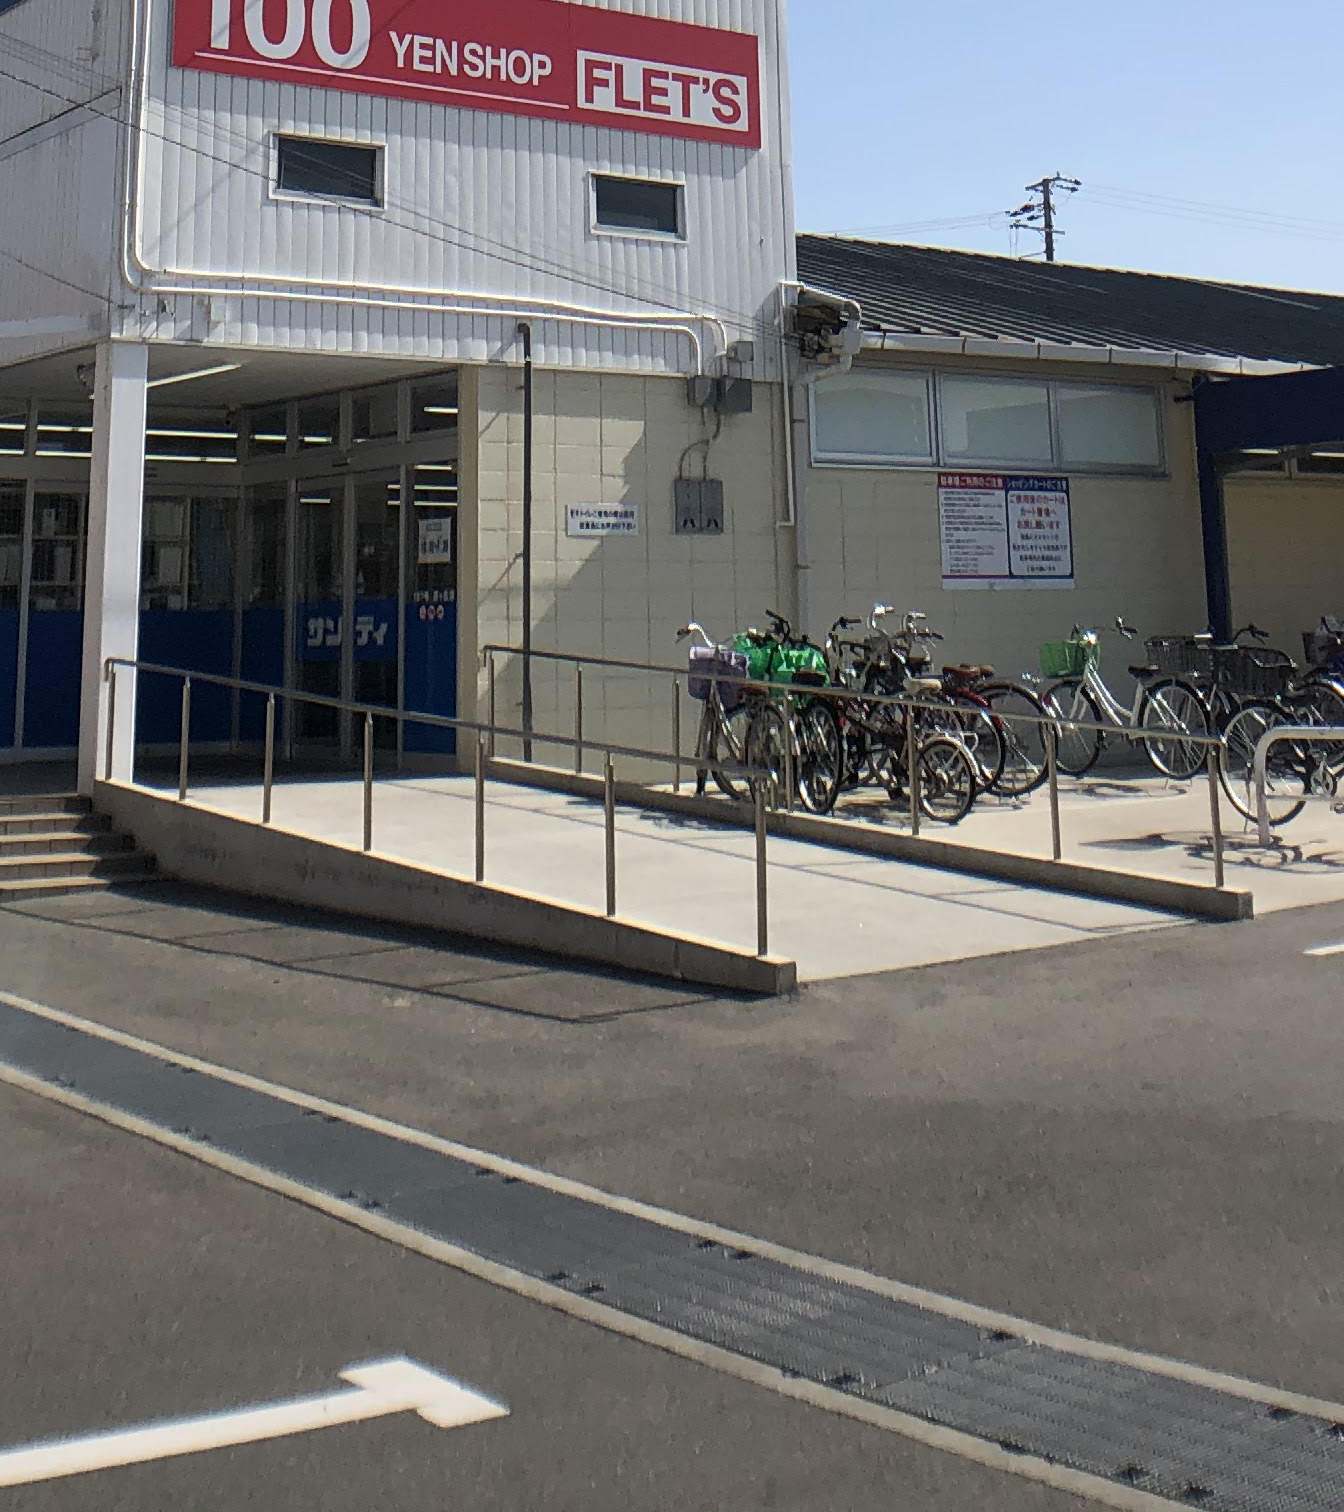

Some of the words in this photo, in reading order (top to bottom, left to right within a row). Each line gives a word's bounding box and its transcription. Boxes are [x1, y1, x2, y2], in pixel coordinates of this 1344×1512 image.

[583, 60, 743, 125] FLET'S
[307, 615, 389, 647] サンディ
